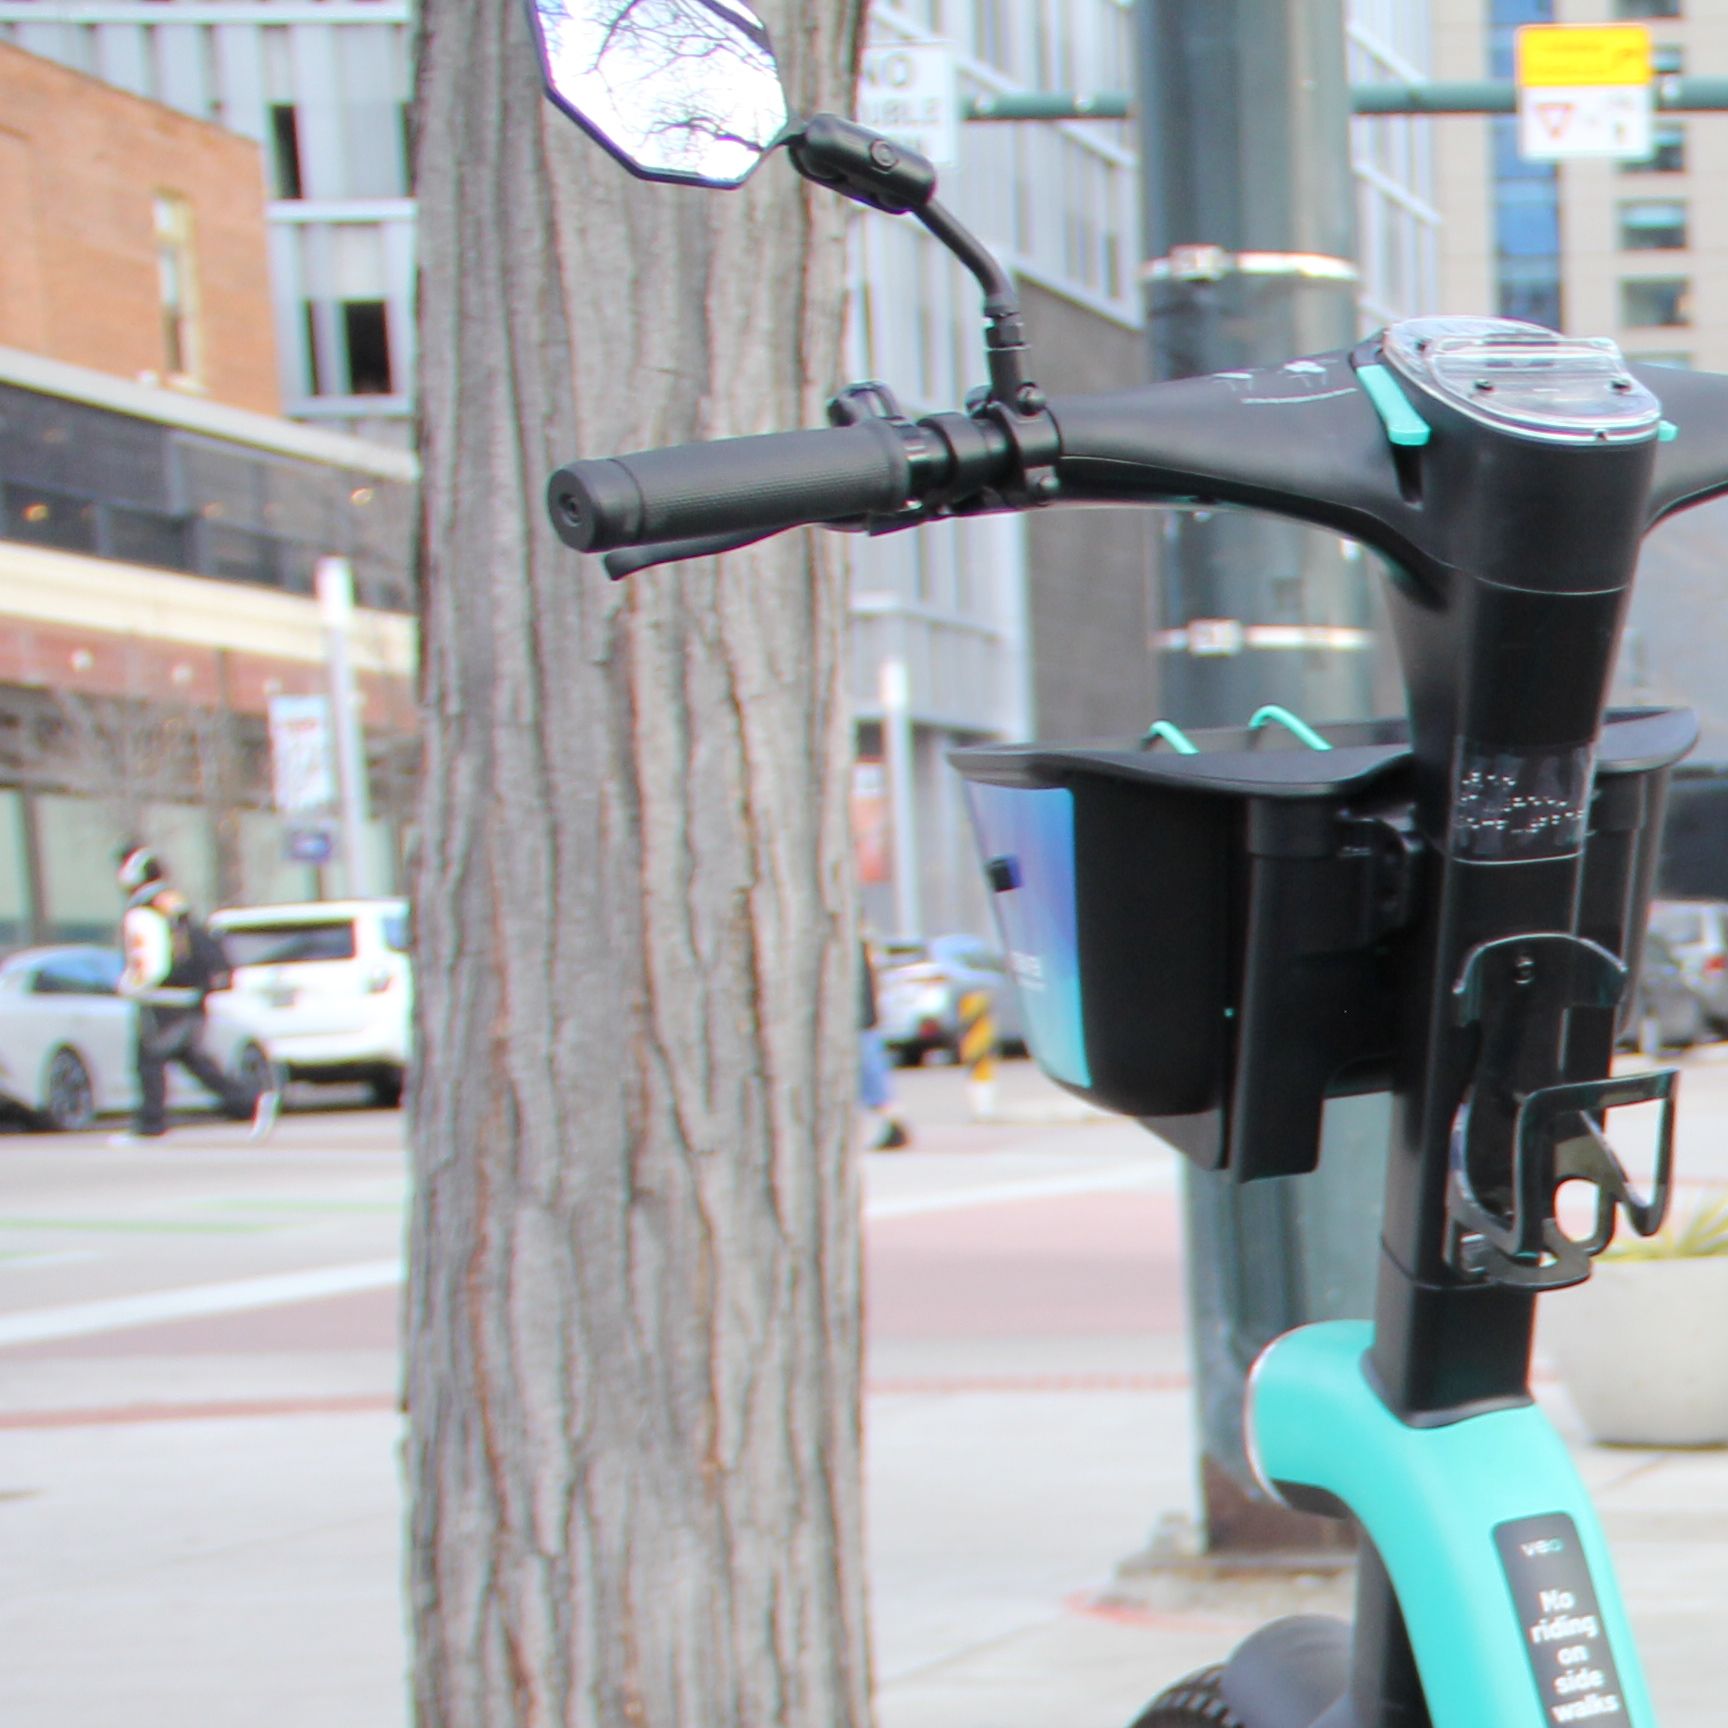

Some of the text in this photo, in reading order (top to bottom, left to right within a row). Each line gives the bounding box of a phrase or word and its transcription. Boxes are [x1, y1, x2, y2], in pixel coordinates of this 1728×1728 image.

[1538, 1589, 1576, 1614] No
[1529, 1614, 1599, 1644] riding
[1557, 1645, 1589, 1666] on
[1553, 1667, 1605, 1695] side
[1551, 1693, 1620, 1723] walks
